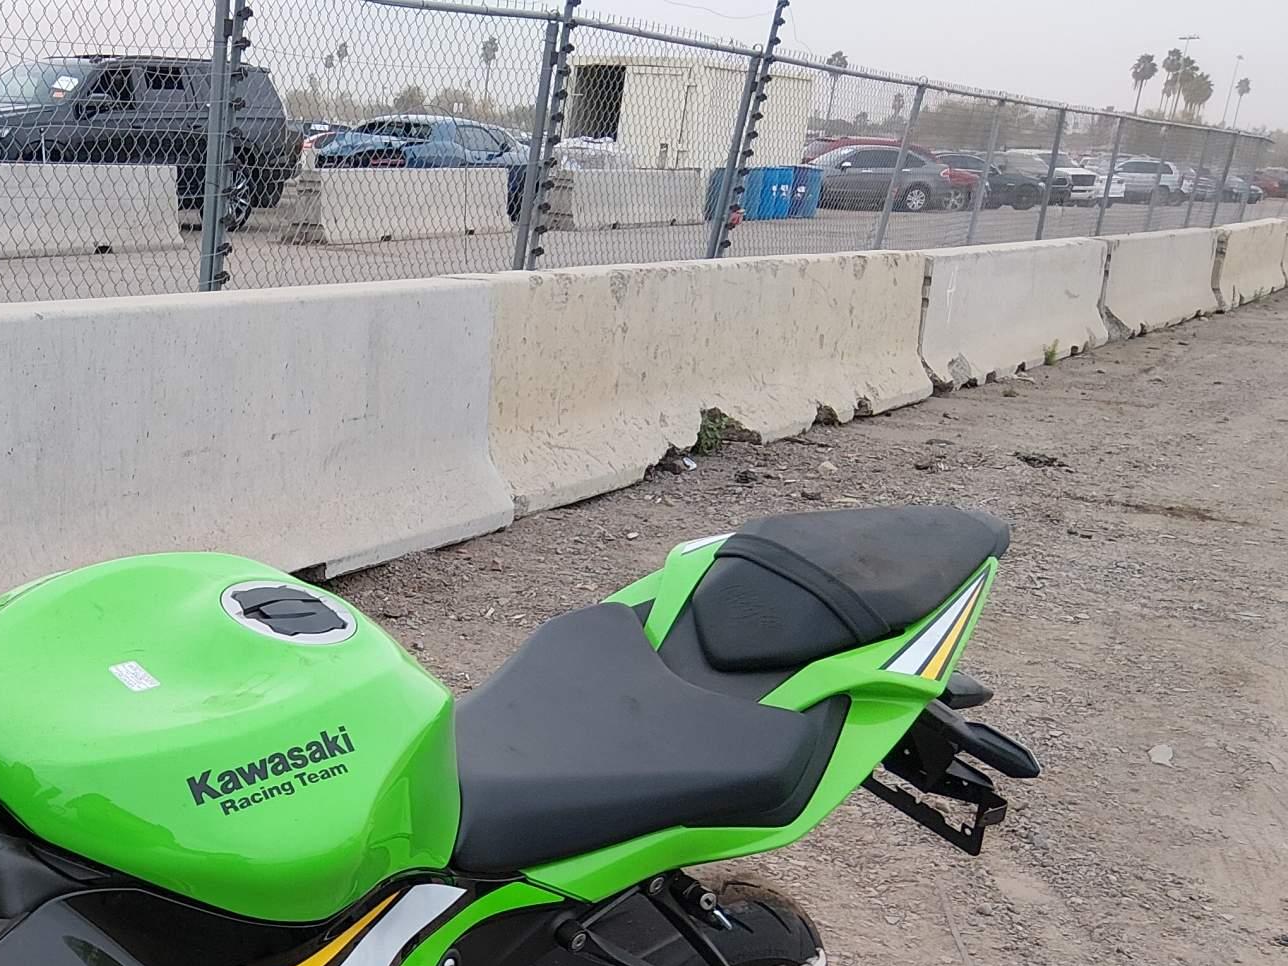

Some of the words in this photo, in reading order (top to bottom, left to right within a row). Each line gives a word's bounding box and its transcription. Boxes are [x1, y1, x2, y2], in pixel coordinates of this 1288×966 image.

[186, 725, 355, 806] Kawasaki
[219, 780, 295, 816] Racing
[294, 763, 349, 787] Team
